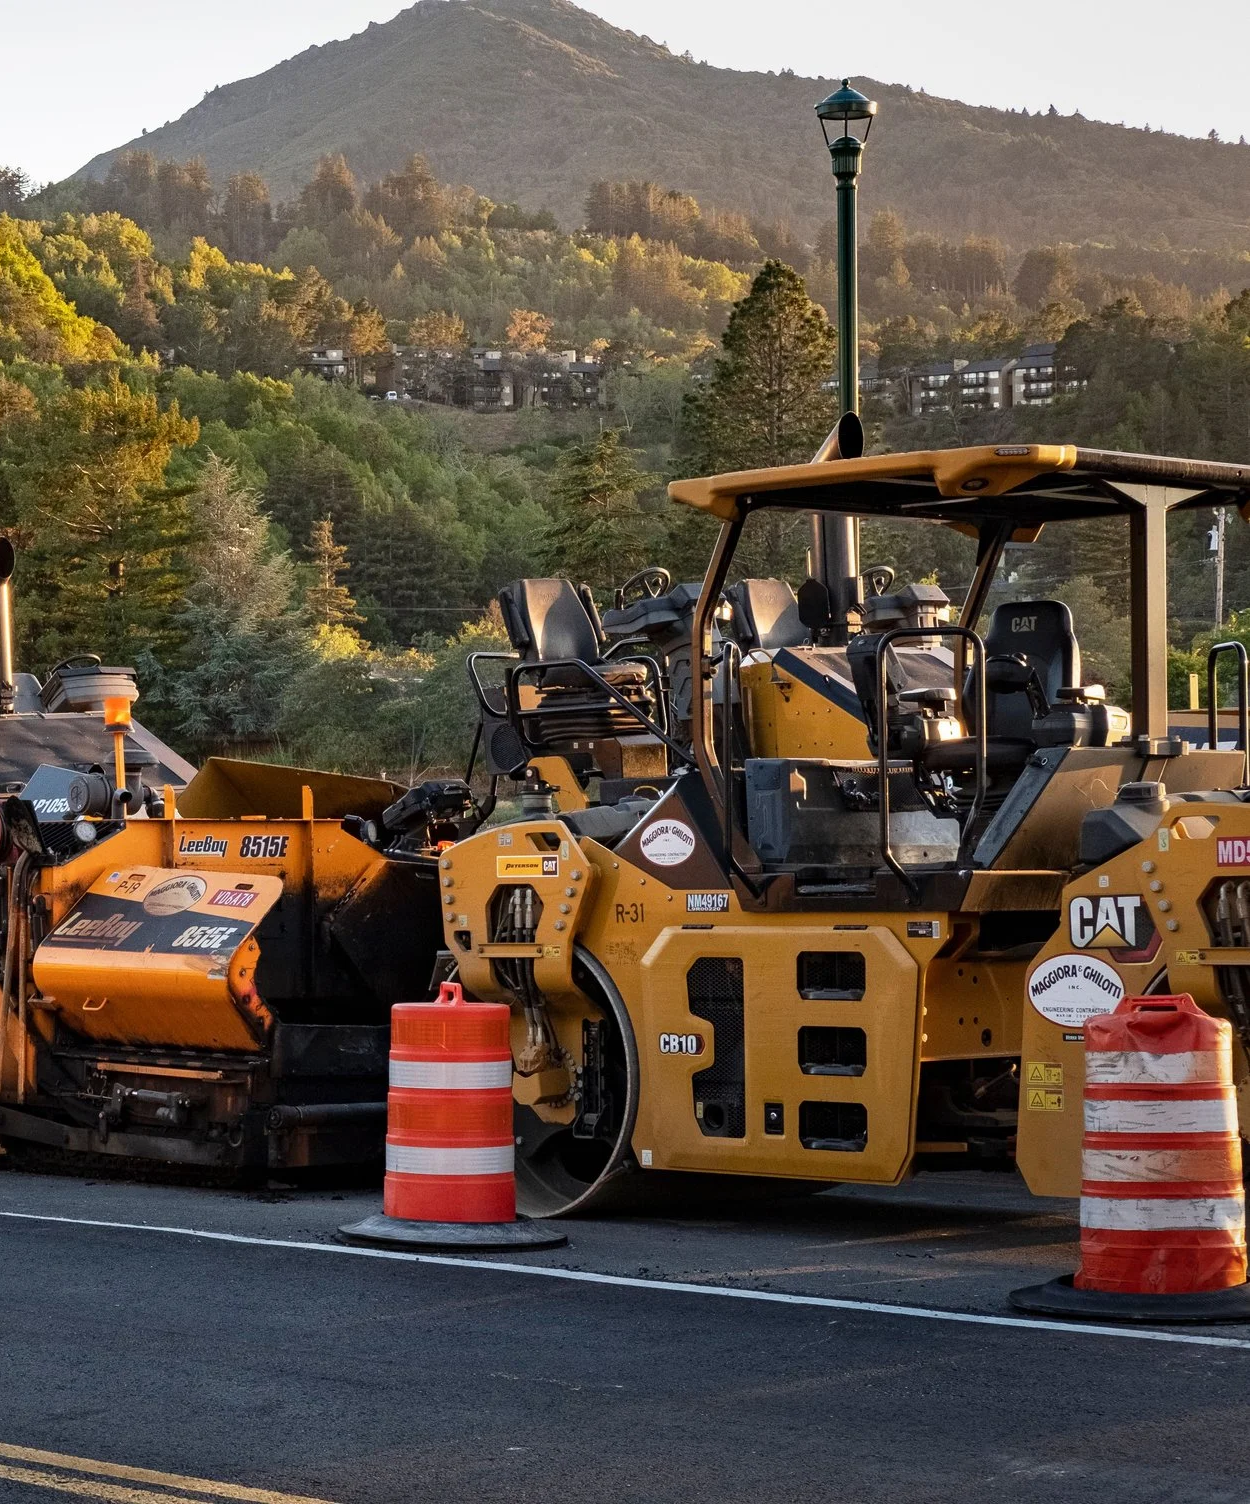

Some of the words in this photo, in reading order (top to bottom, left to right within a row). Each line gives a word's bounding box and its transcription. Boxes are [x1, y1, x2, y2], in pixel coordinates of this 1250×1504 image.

[1011, 616, 1037, 632] CAT
[33, 798, 70, 813] P1055
[642, 826, 669, 848] MAGGIORA
[672, 826, 694, 847] GHILOTTI
[179, 835, 228, 858] LeeBoy
[239, 835, 290, 858] 8515E
[543, 860, 557, 872] CAT
[113, 880, 141, 894] P-19
[149, 881, 187, 897] MAGGIORA
[213, 890, 254, 906] VD6A78
[688, 894, 729, 908] NM49167
[616, 903, 645, 923] R-31
[1070, 895, 1141, 948] CAT
[53, 912, 144, 946] LeeBoy
[172, 926, 238, 948] 8515E
[1031, 965, 1078, 997] MAGGIORA
[1083, 966, 1122, 999] GHILOTTI
[660, 1033, 697, 1054] CB10
